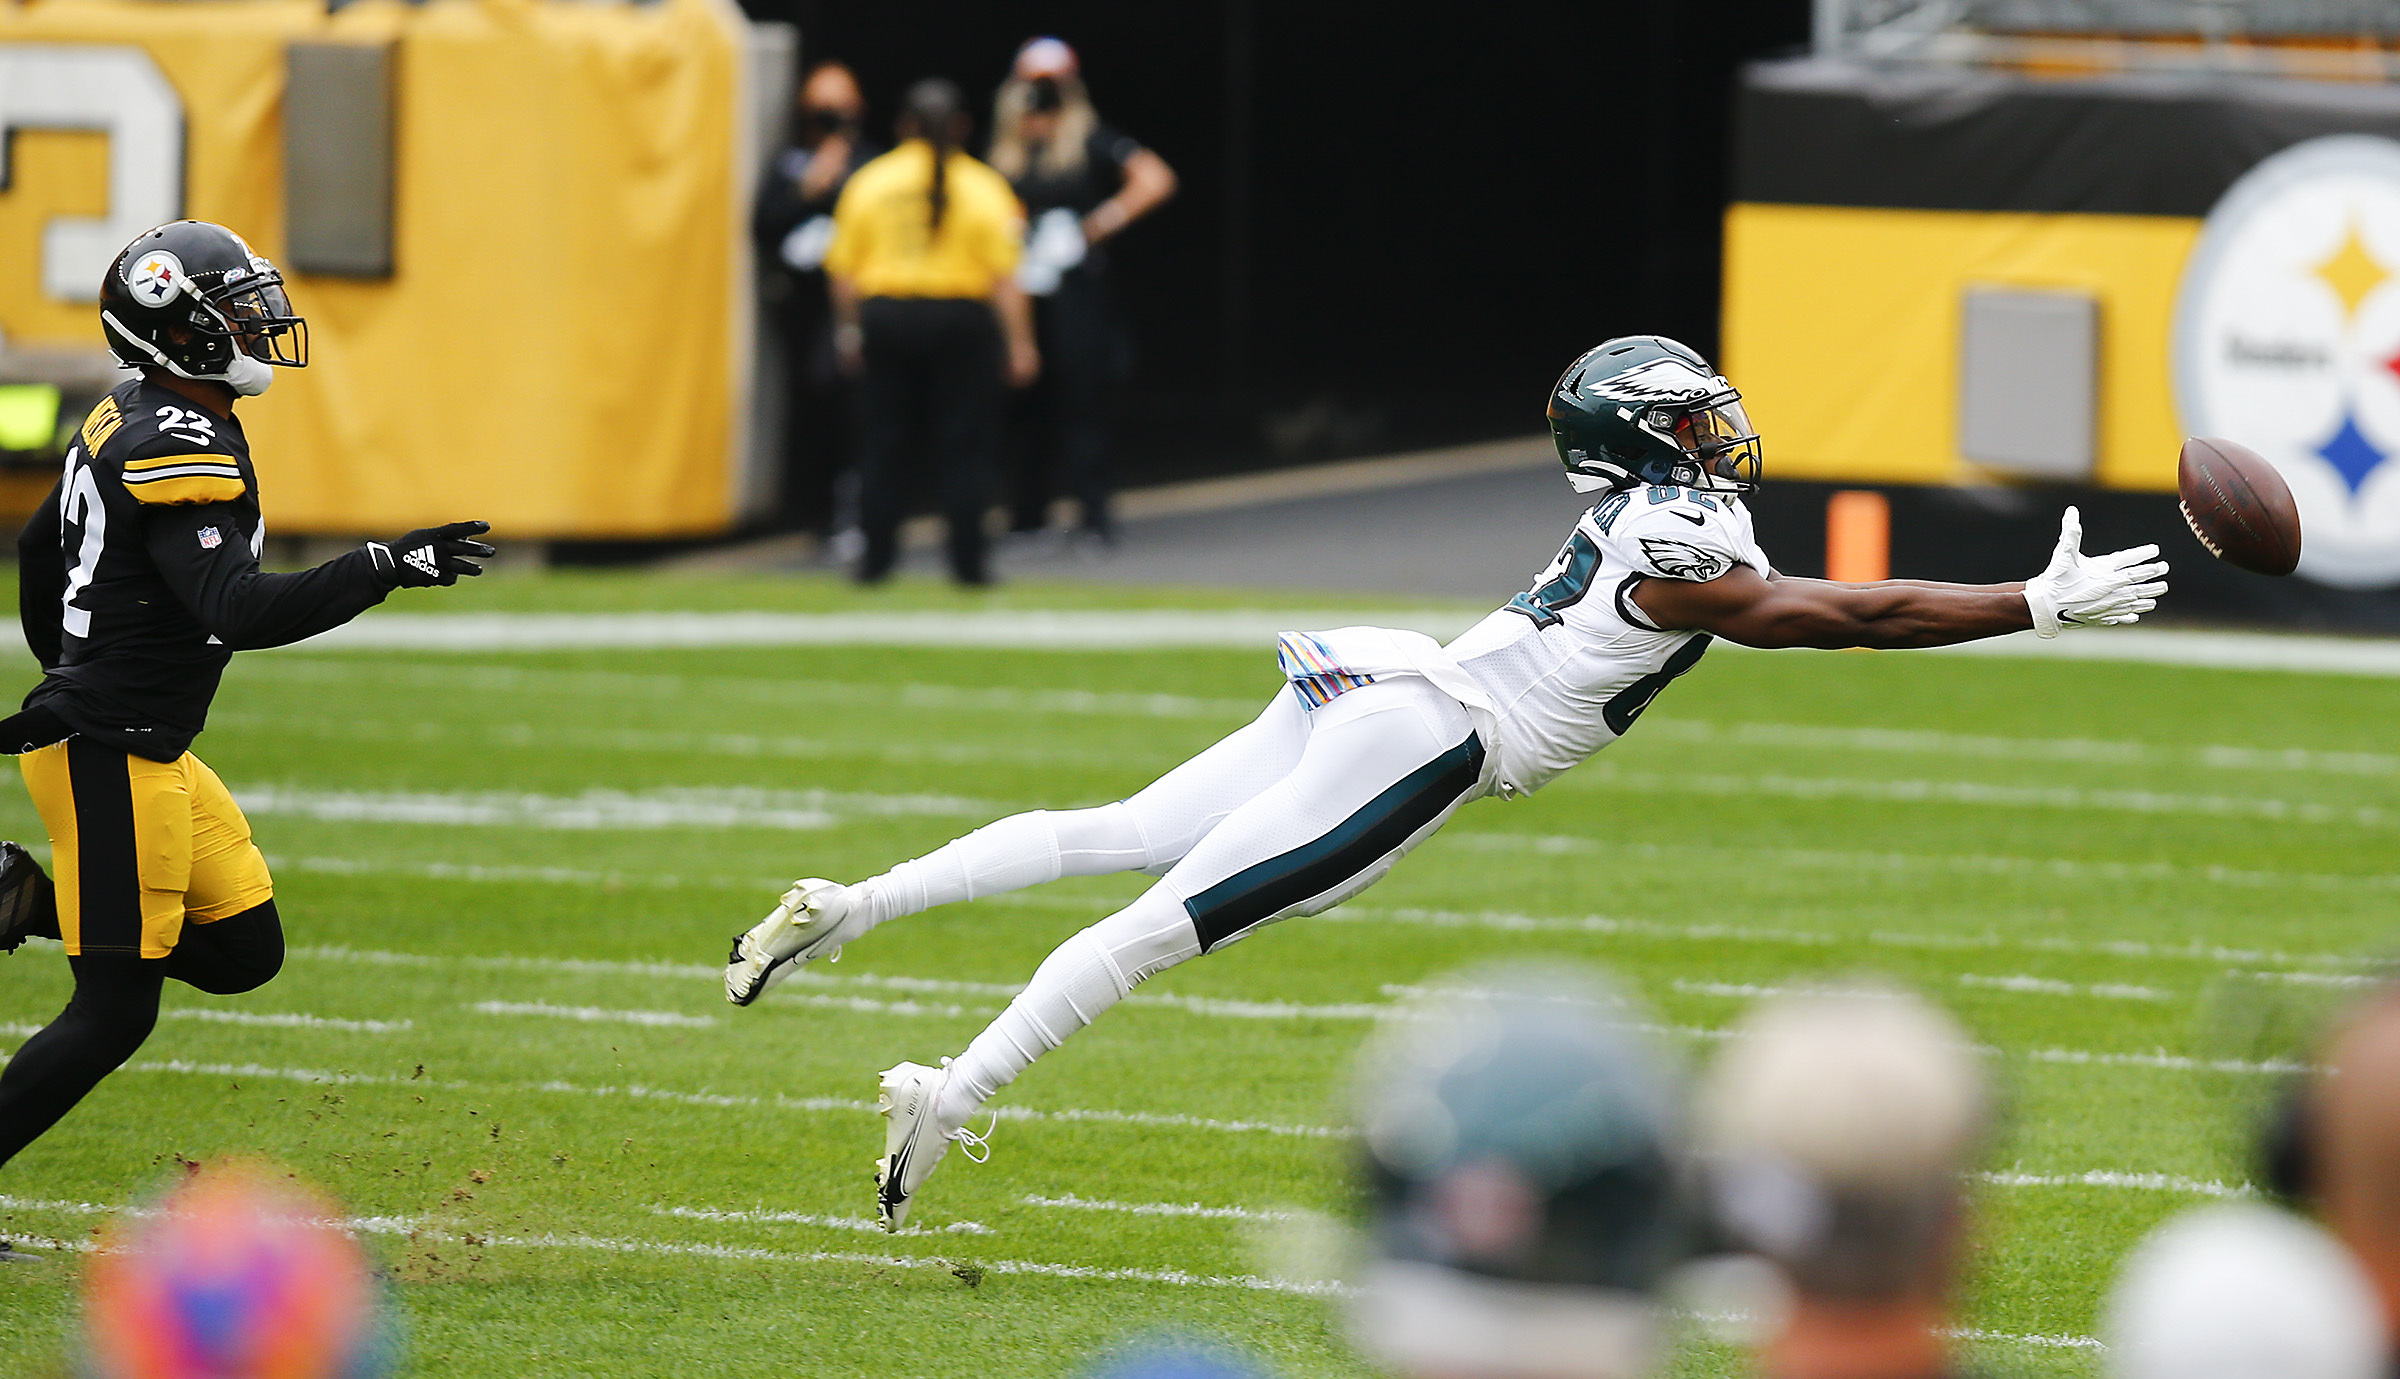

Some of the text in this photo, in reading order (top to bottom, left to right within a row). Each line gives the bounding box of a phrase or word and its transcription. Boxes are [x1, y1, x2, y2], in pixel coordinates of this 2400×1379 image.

[155, 405, 217, 438] 22
[203, 535, 221, 547] NFL
[402, 554, 440, 578] adidas
